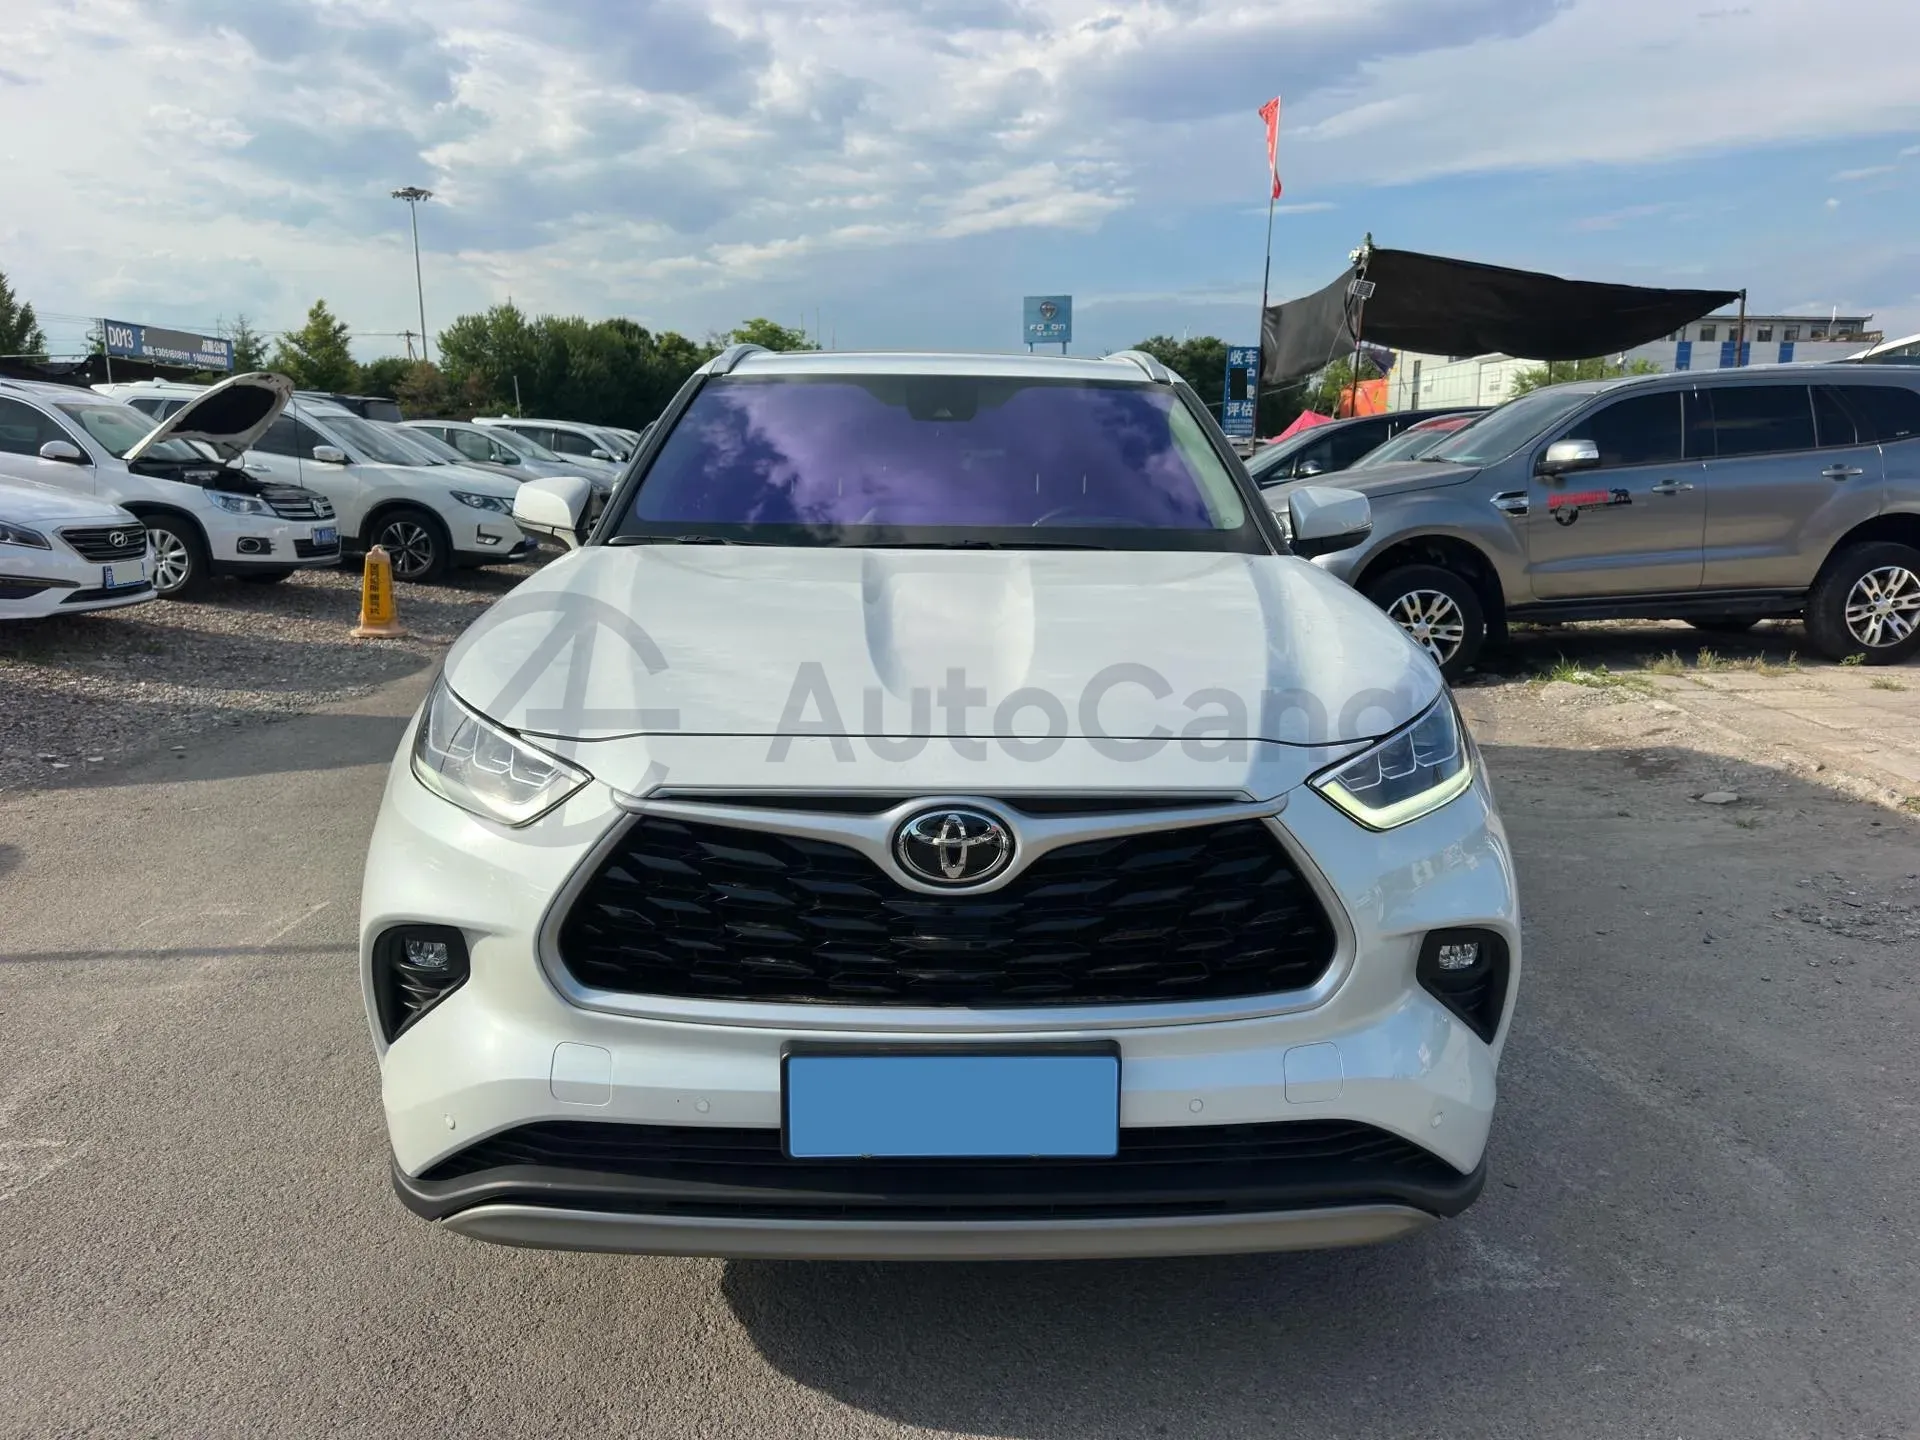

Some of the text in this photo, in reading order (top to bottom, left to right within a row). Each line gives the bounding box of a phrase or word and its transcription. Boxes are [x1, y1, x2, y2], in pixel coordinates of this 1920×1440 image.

[108, 326, 134, 349] D013
[1230, 349, 1258, 365] 收车
[1226, 402, 1254, 417] 评估
